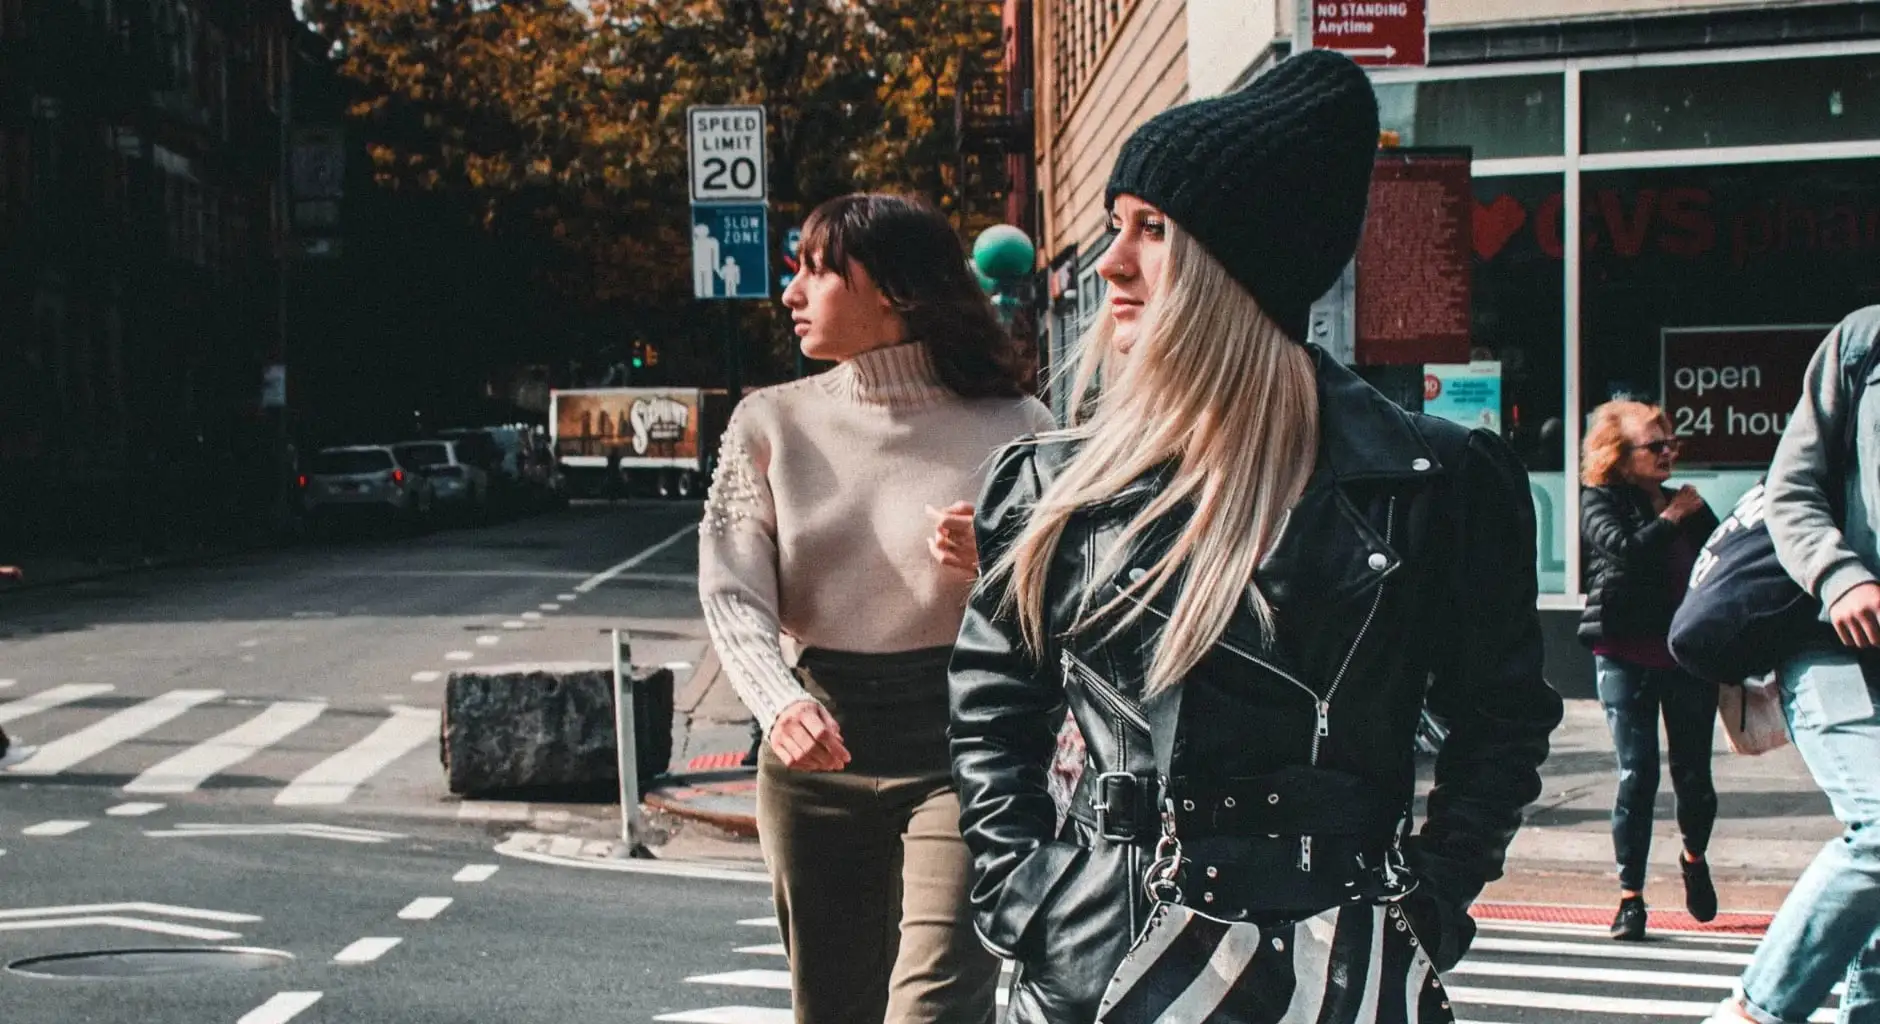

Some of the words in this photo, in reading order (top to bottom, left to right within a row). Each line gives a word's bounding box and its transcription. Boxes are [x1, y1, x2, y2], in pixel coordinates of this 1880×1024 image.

[1317, 3, 1337, 17] NO
[1341, 3, 1407, 17] STANDING
[1319, 20, 1374, 36] Anytime
[698, 116, 756, 132] SPEED
[702, 135, 753, 151] LIMIT
[702, 157, 756, 190] 20
[725, 215, 760, 229] SLOW
[1535, 187, 1714, 257] CVS
[725, 231, 760, 244] ZONE
[1674, 365, 1761, 396] open
[1675, 406, 1714, 436] 24
